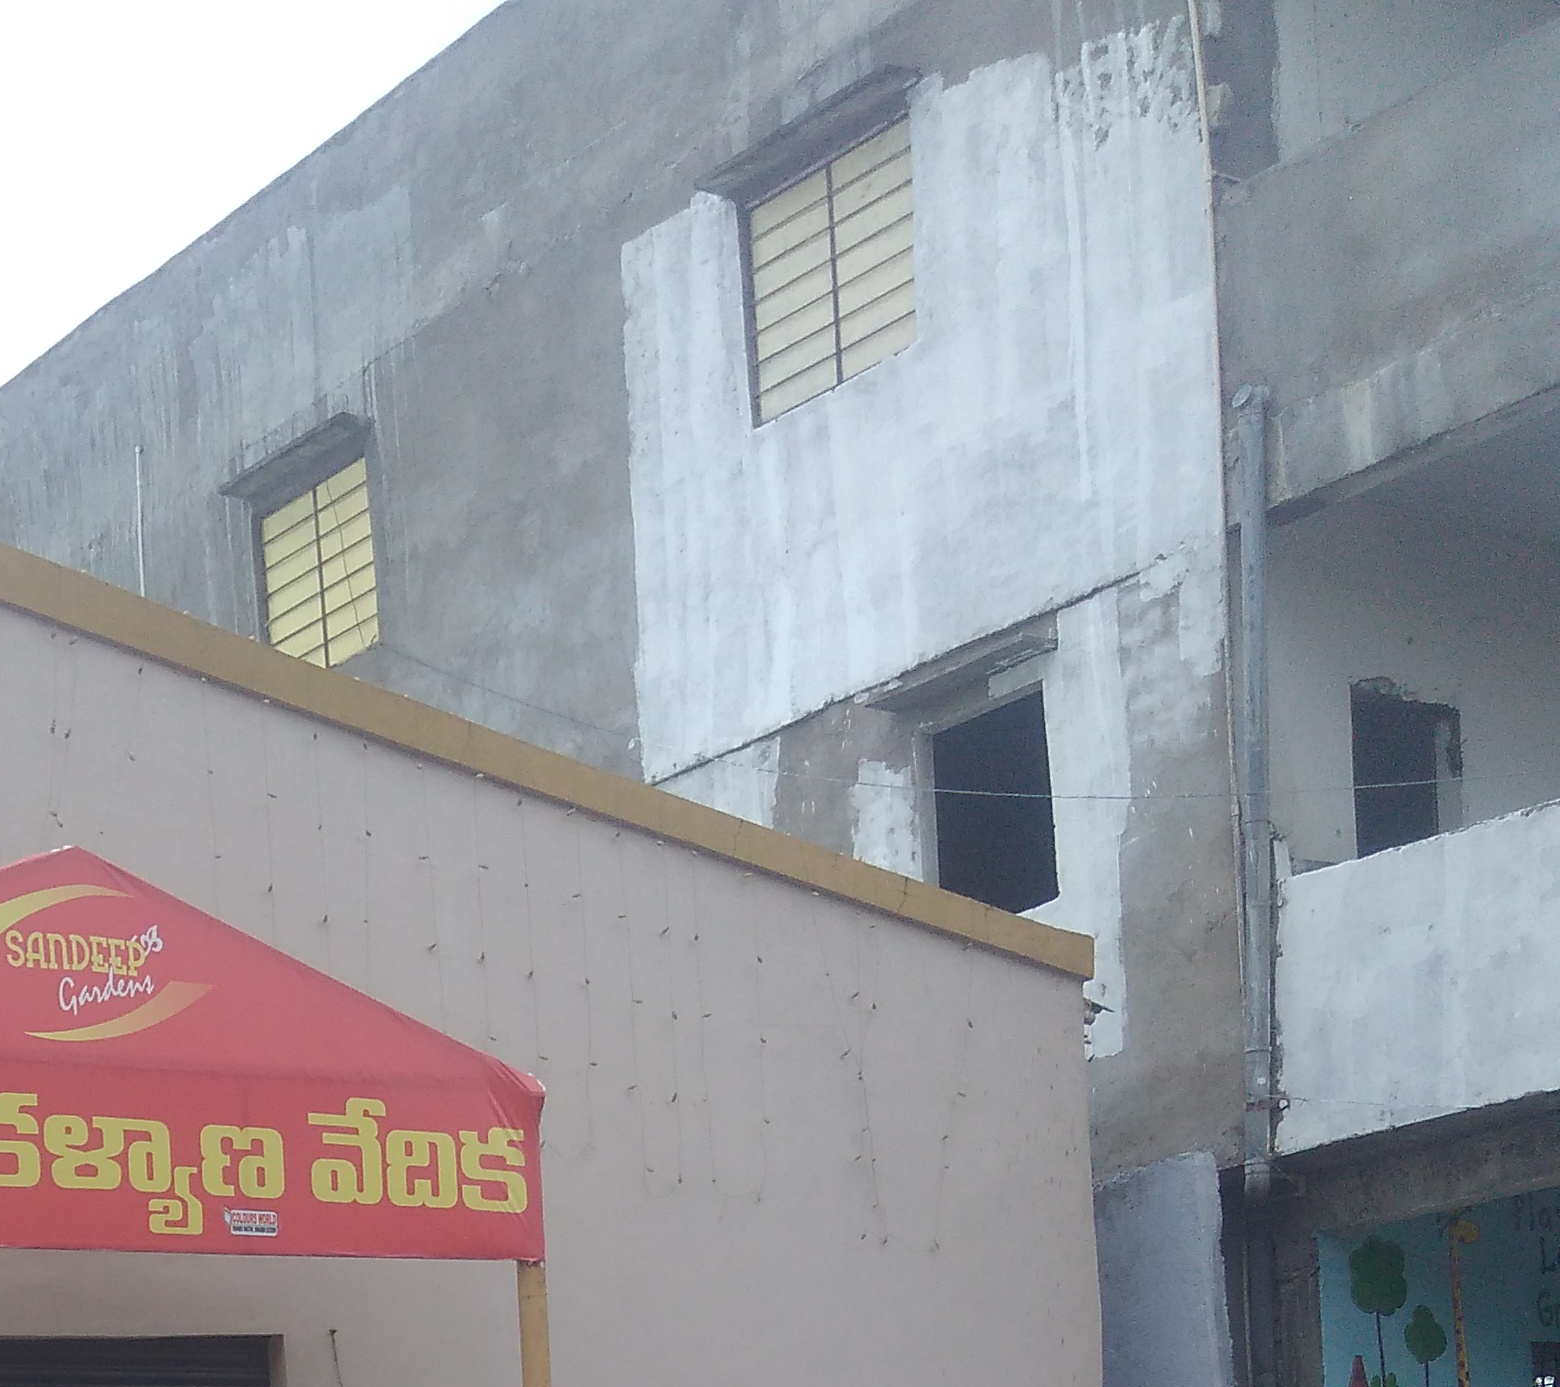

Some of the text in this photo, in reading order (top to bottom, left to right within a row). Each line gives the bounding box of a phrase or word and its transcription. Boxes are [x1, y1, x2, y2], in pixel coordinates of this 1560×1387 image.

[5, 930, 146, 976] SANDEEP
[58, 966, 155, 1016] Gardens
[307, 1097, 528, 1214] వేదిక
